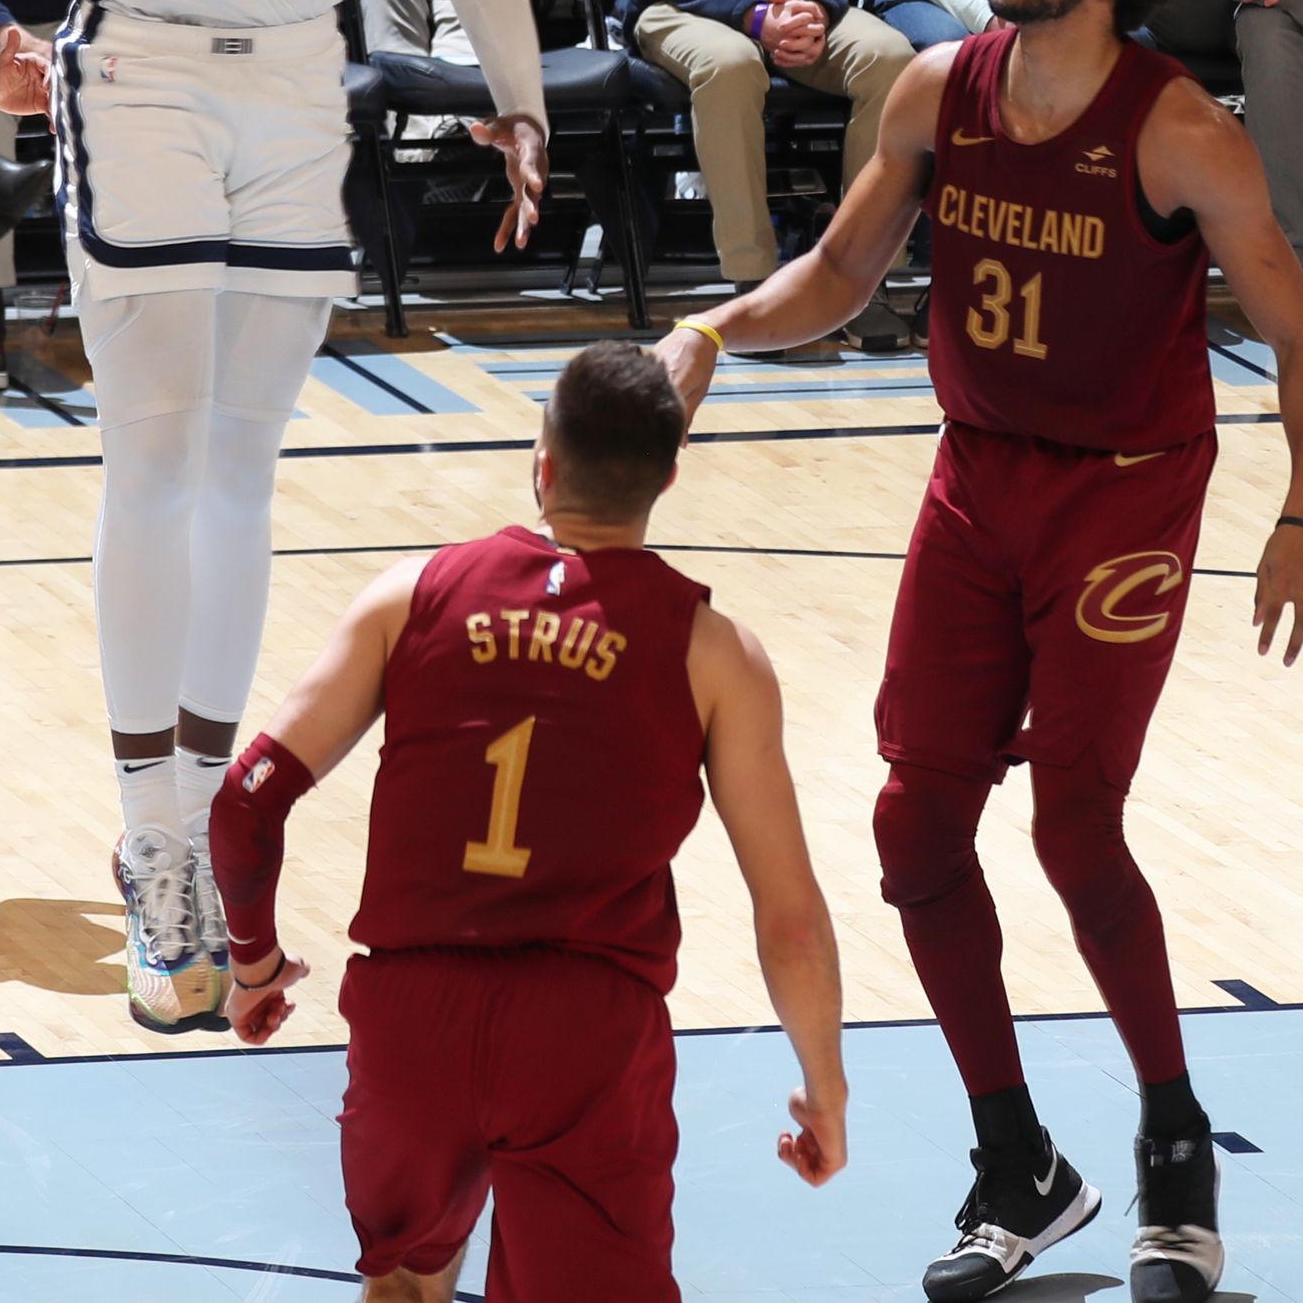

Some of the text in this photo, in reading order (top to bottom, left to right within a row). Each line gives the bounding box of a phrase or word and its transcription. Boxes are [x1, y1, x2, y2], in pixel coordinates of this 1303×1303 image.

[1075, 162, 1117, 178] CLIFFS
[938, 184, 1105, 259] CLEVELAND
[966, 258, 1048, 360] 31
[465, 609, 628, 681] STRUS
[463, 714, 537, 878] 1
